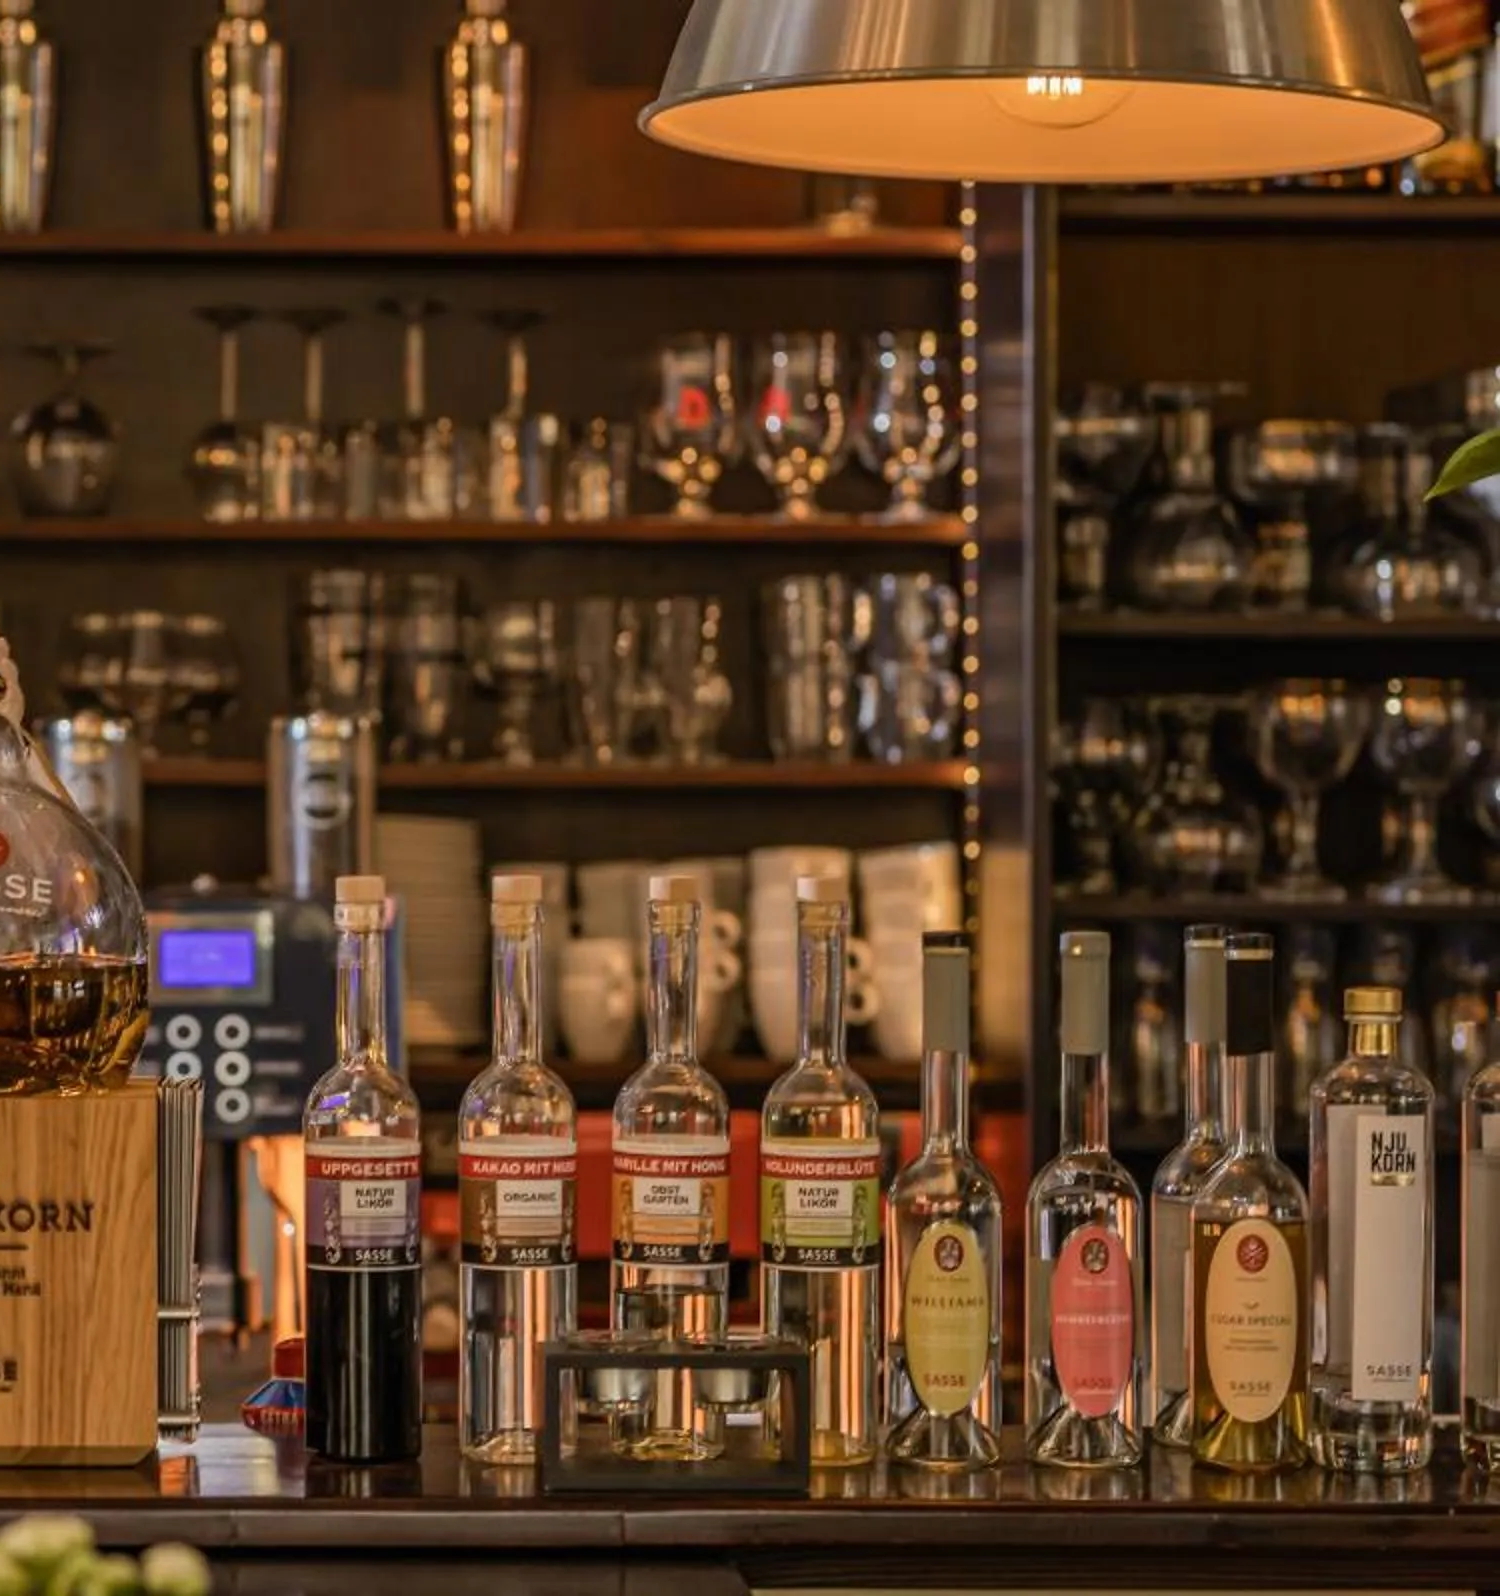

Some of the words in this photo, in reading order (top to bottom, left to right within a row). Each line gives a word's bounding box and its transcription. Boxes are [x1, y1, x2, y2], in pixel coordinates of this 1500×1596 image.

[1371, 1131, 1407, 1153] NJU
[473, 1161, 521, 1175] KAKAO
[523, 1161, 551, 1176] MIT
[662, 1158, 690, 1174] MIT
[1371, 1152, 1416, 1173] KORN
[355, 1187, 395, 1198] NATUR
[503, 1192, 558, 1203] ORGANIC
[798, 1187, 840, 1198] NATUR
[643, 1194, 689, 1206] GARTEN
[800, 1197, 838, 1209] LIKÖR
[355, 1248, 394, 1261] SASSE
[511, 1247, 550, 1260] SASSE
[643, 1245, 683, 1257] SASSE
[798, 1248, 838, 1261] SASSE
[3, 1281, 42, 1297] Hand
[1365, 1364, 1412, 1377] SASSE
[924, 1373, 967, 1388] SASSE
[1229, 1380, 1271, 1393] SASSE
